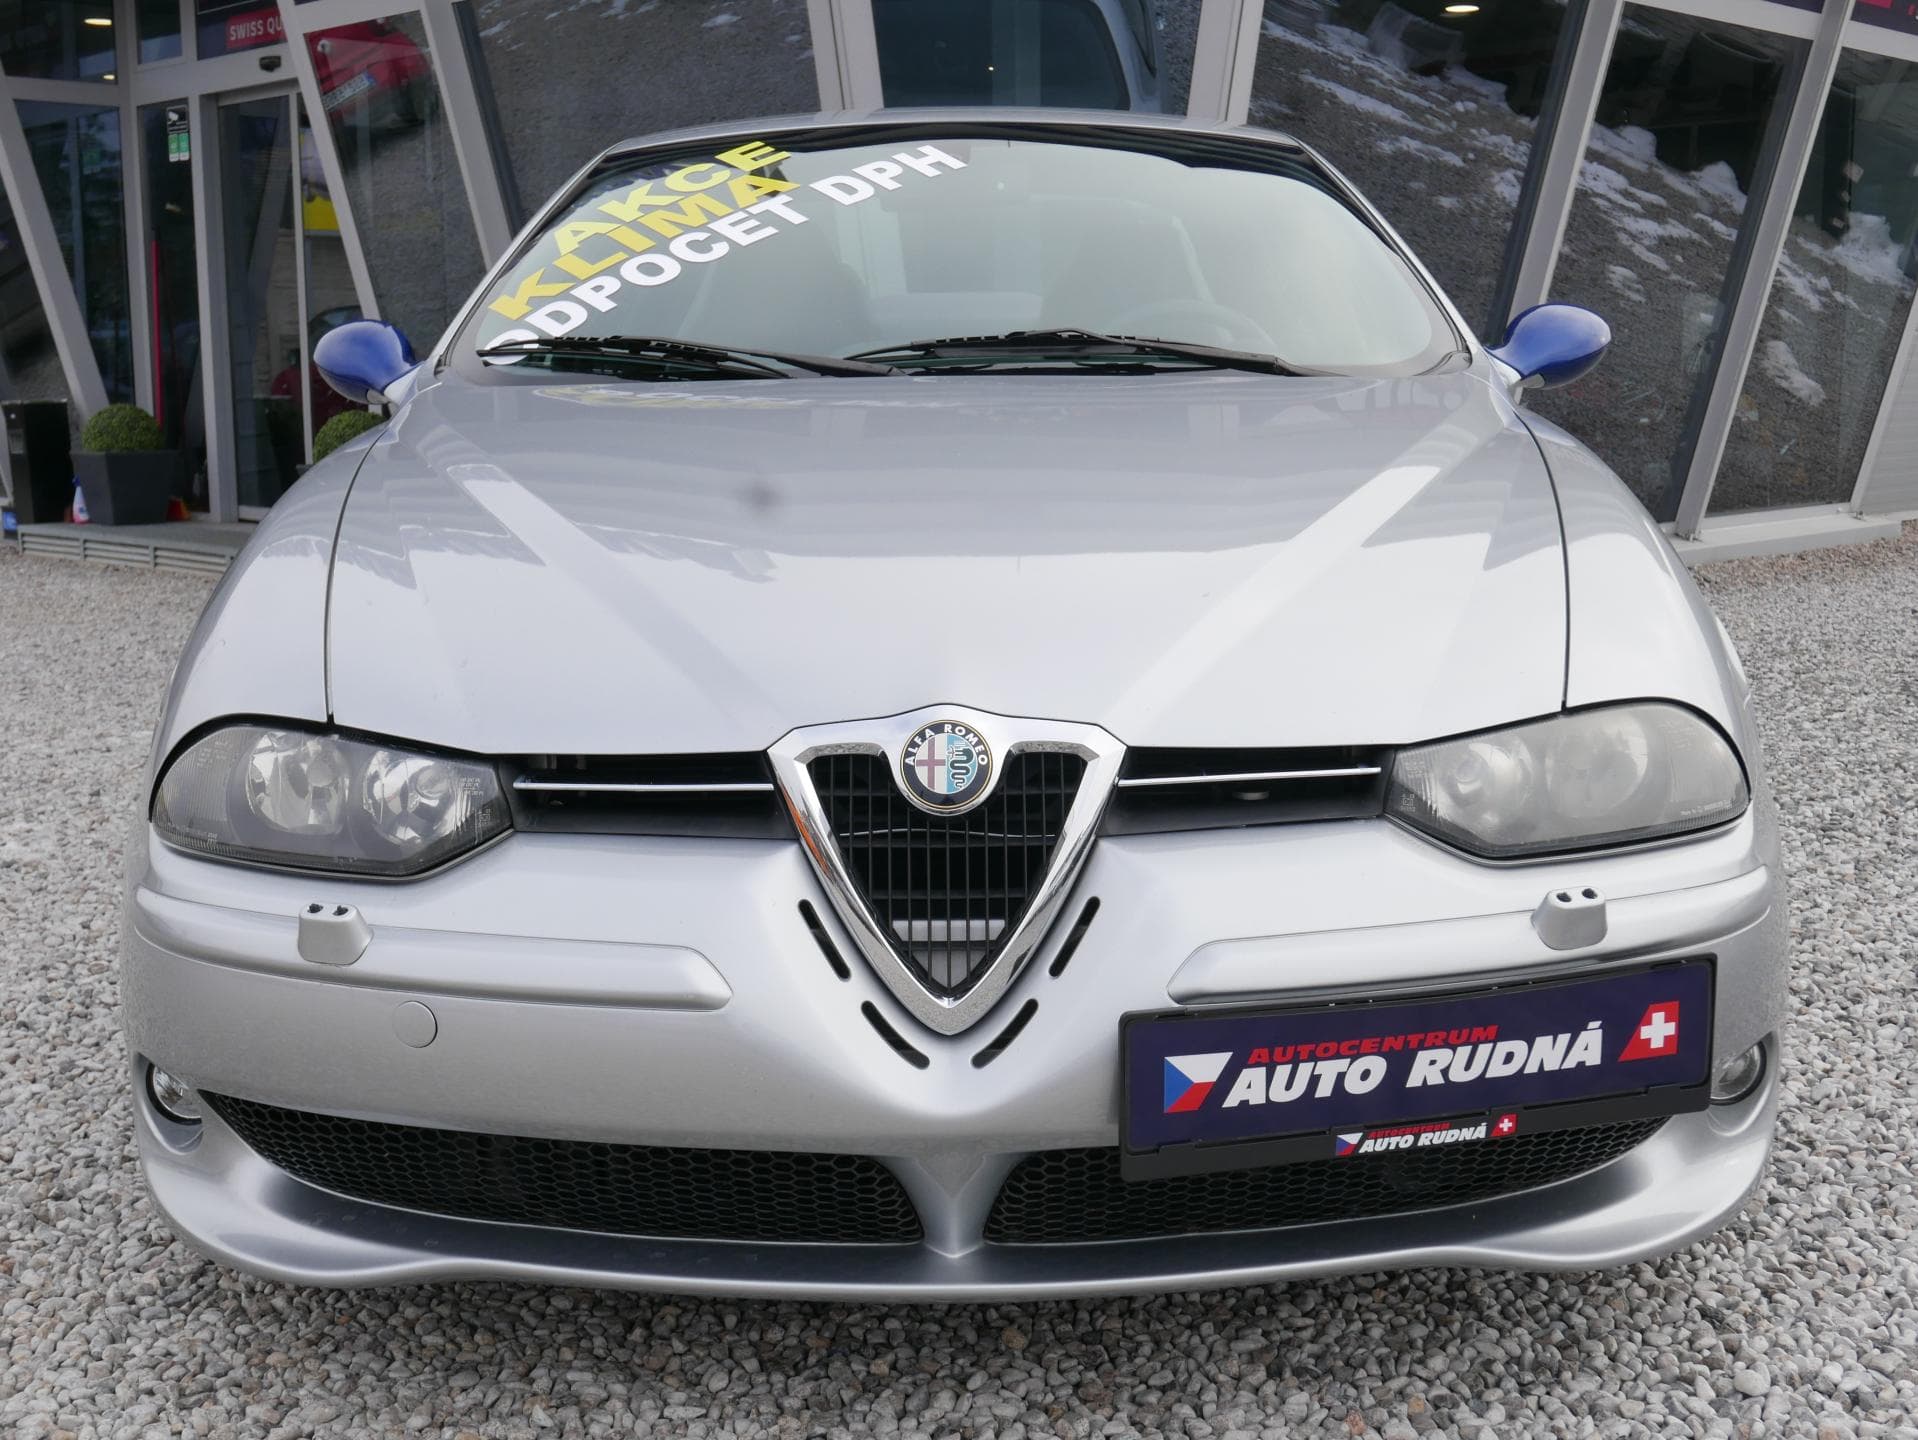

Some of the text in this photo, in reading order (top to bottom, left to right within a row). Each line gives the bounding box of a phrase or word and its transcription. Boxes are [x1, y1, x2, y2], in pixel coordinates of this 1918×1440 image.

[230, 20, 264, 40] SWISS
[553, 141, 792, 256] AKCE
[482, 145, 968, 366] ODPOCET DPH
[488, 174, 801, 321] KLIMA
[905, 724, 988, 766] ALFA ROMEO
[1221, 1020, 1602, 1108] AUTO RUDNÁ
[1246, 1025, 1499, 1065] AUTOCENTRUM
[1358, 1122, 1488, 1154] AUTO RUDNÁ
[1368, 1122, 1451, 1140] AUTOCENTRUM
